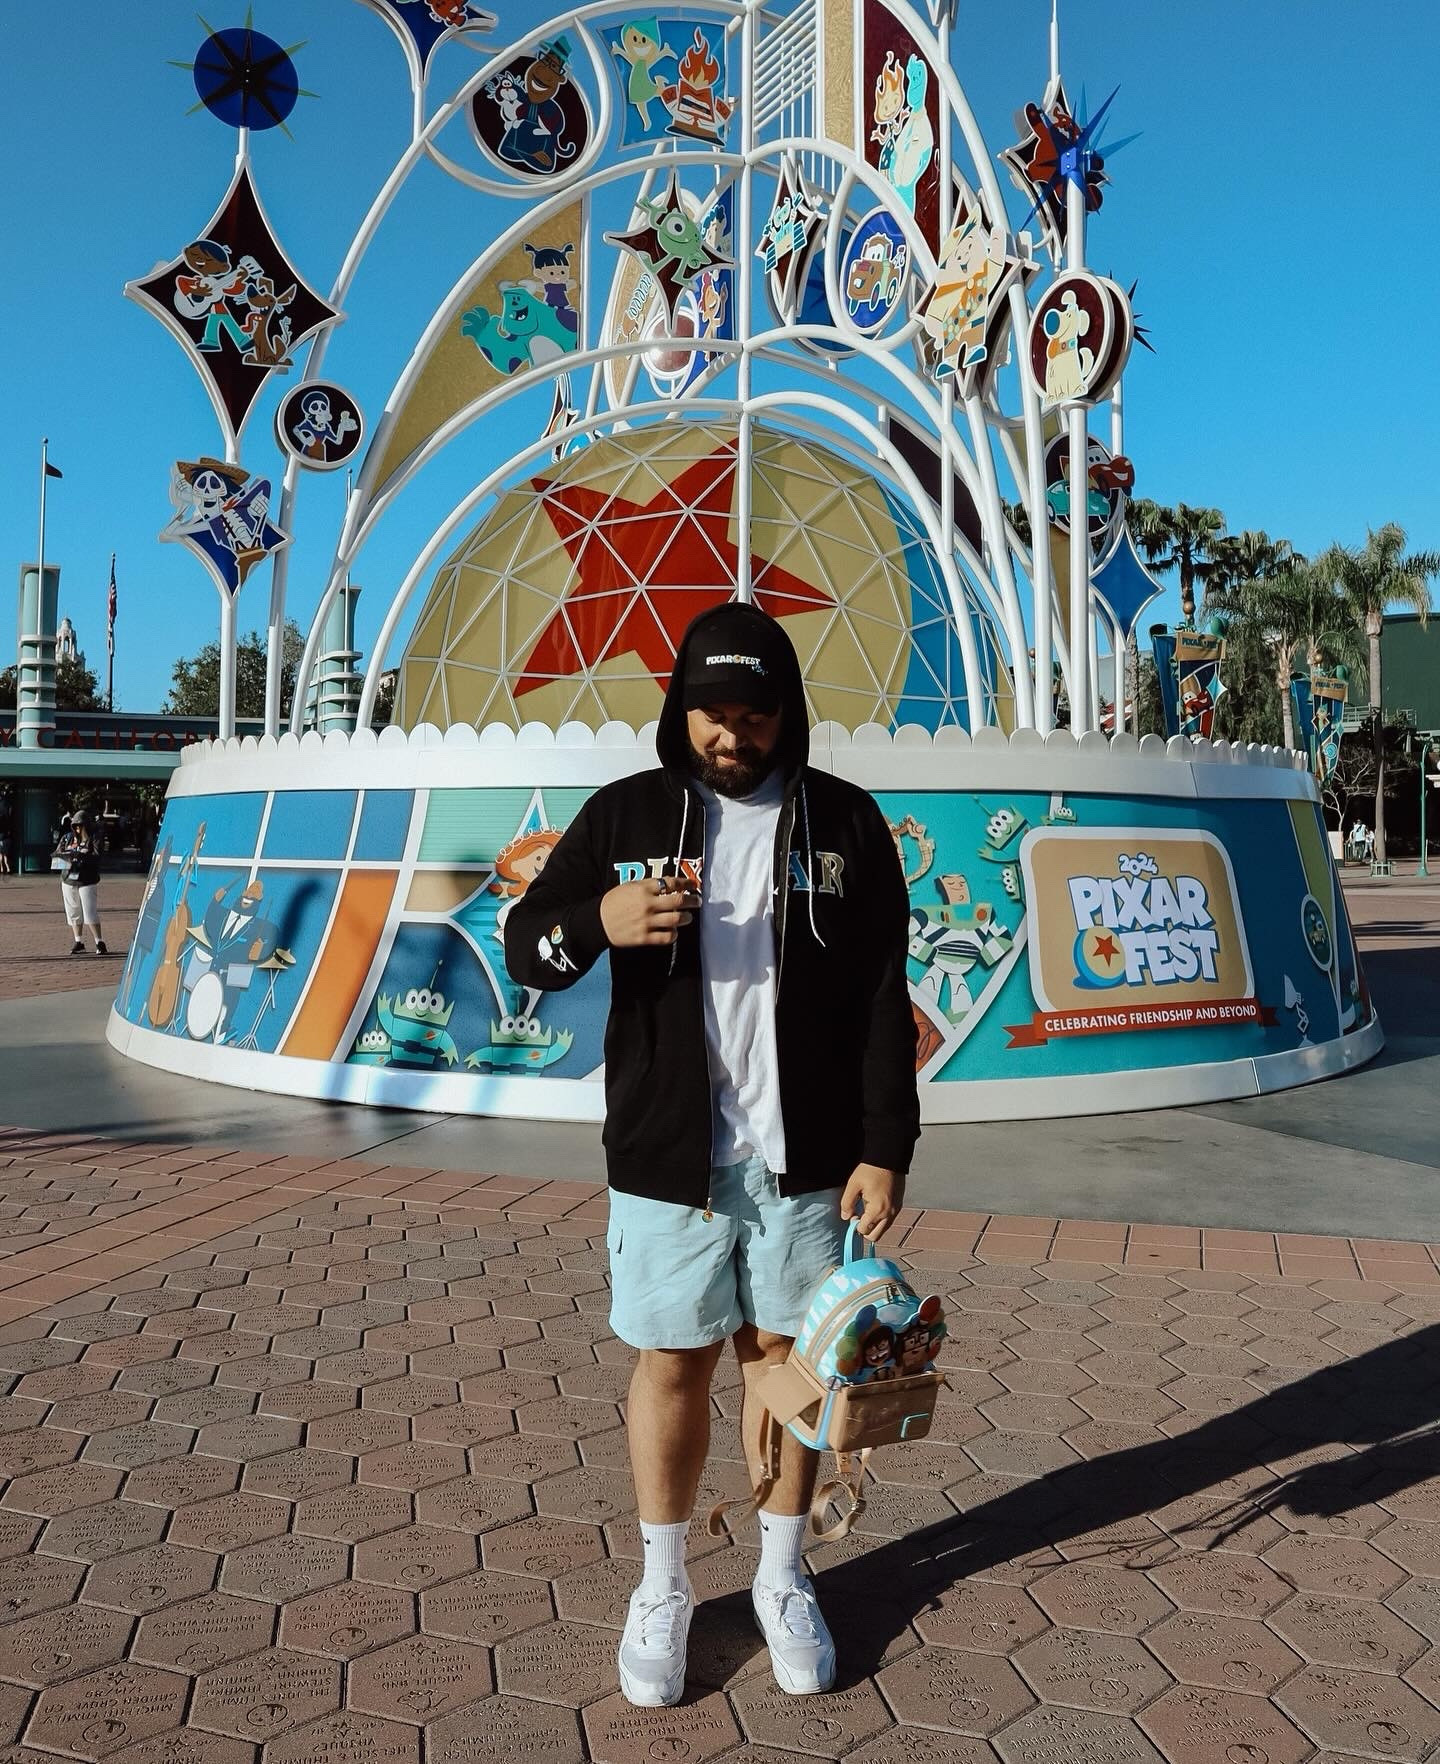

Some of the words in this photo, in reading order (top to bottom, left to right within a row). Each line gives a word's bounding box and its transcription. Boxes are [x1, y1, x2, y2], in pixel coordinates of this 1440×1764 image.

[705, 655, 733, 665] PIXAR
[740, 656, 761, 665] FEST
[37, 727, 242, 750] CALIFOR
[1117, 852, 1159, 876] 2024
[1068, 876, 1215, 931] PIXAR
[1118, 929, 1219, 986] FEST
[1044, 1013, 1127, 1032] CELEBRATING
[1130, 1008, 1193, 1025] FRIENDSHIP
[1195, 1007, 1218, 1019] AND
[1219, 1005, 1257, 1018] BEYOND
[817, 1703, 854, 1715] MIKE
[647, 1724, 677, 1736] AND
[680, 1718, 724, 1732] ALLAN
[603, 1728, 644, 1741] DIANE
